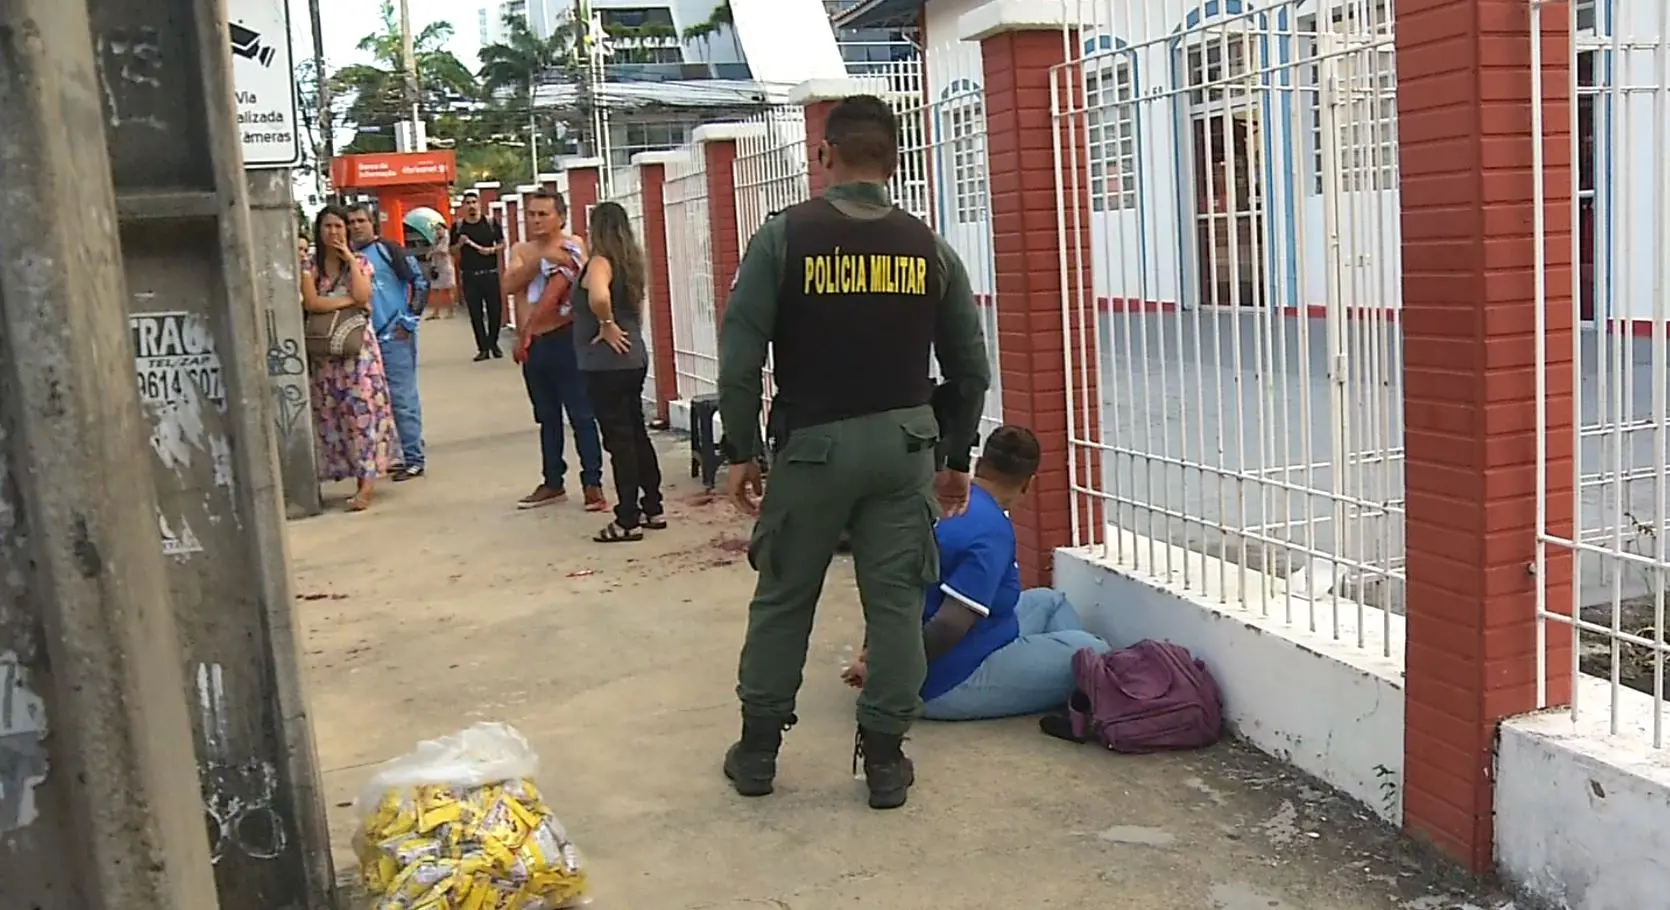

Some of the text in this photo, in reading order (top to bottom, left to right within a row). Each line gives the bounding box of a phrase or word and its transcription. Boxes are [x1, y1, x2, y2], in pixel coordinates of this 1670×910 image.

[235, 91, 257, 104] Via
[237, 110, 284, 123] alizada
[240, 131, 291, 143] âmeras
[804, 246, 926, 295] POLÍCIA MILITAR
